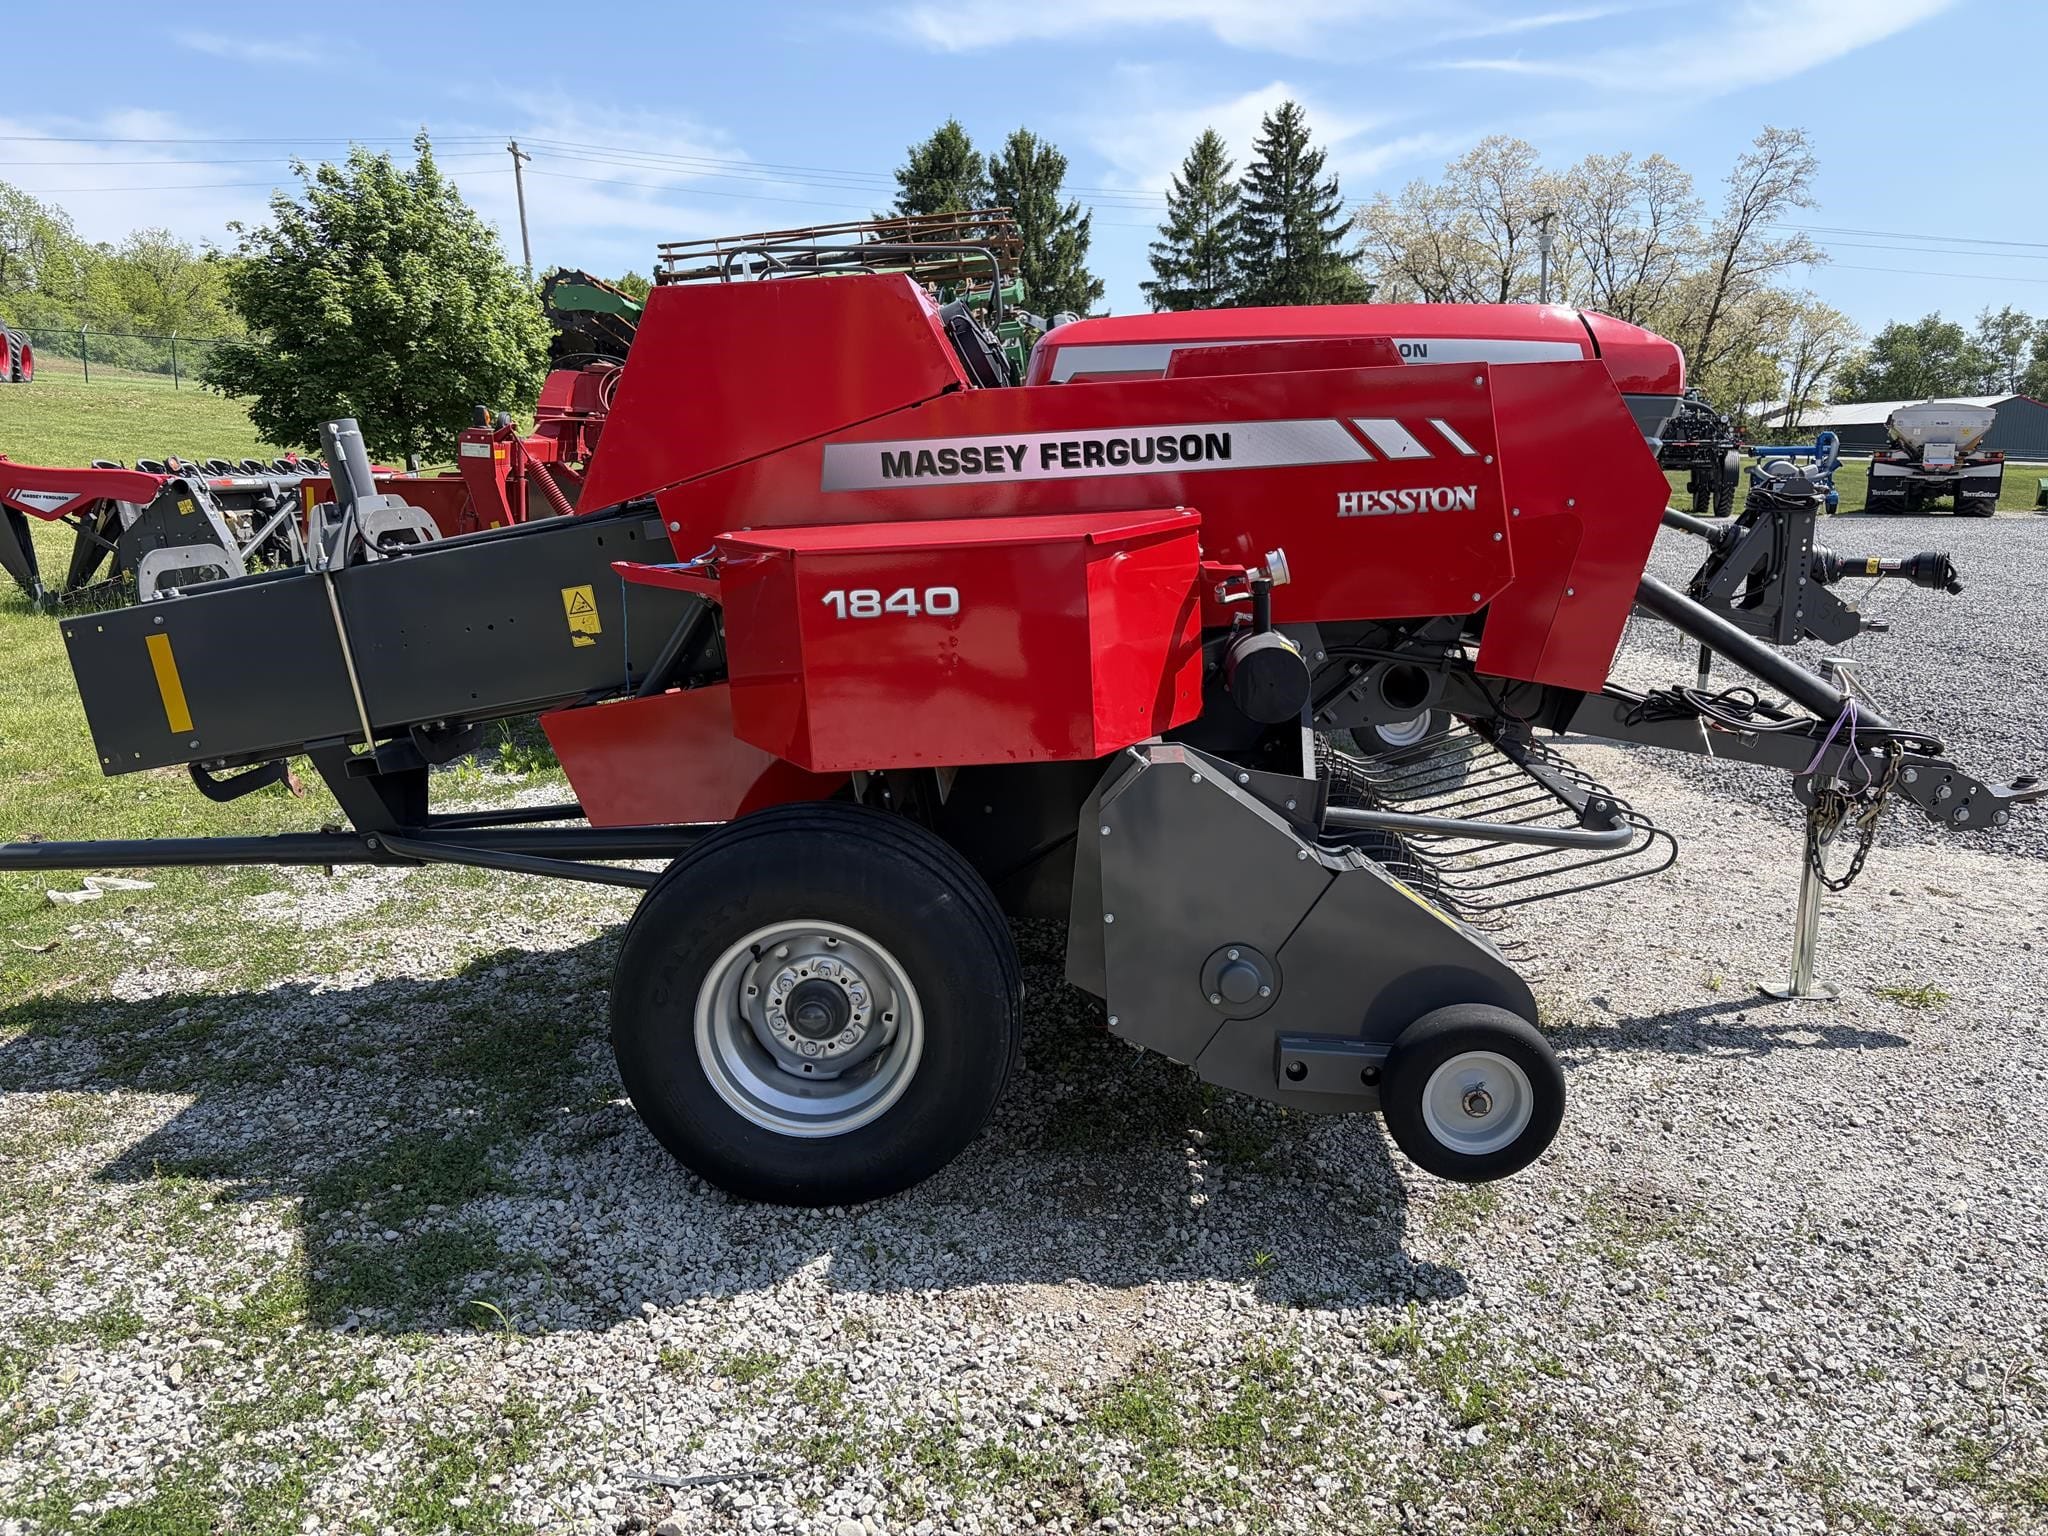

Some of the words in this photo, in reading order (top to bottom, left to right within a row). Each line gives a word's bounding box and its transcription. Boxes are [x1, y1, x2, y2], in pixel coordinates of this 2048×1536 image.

[881, 444, 1028, 479] MASSEY
[1040, 432, 1232, 469] FERGUSON
[1336, 485, 1478, 518] HESSTON
[1962, 490, 1998, 498] TerraGator
[821, 586, 960, 620] 1840
